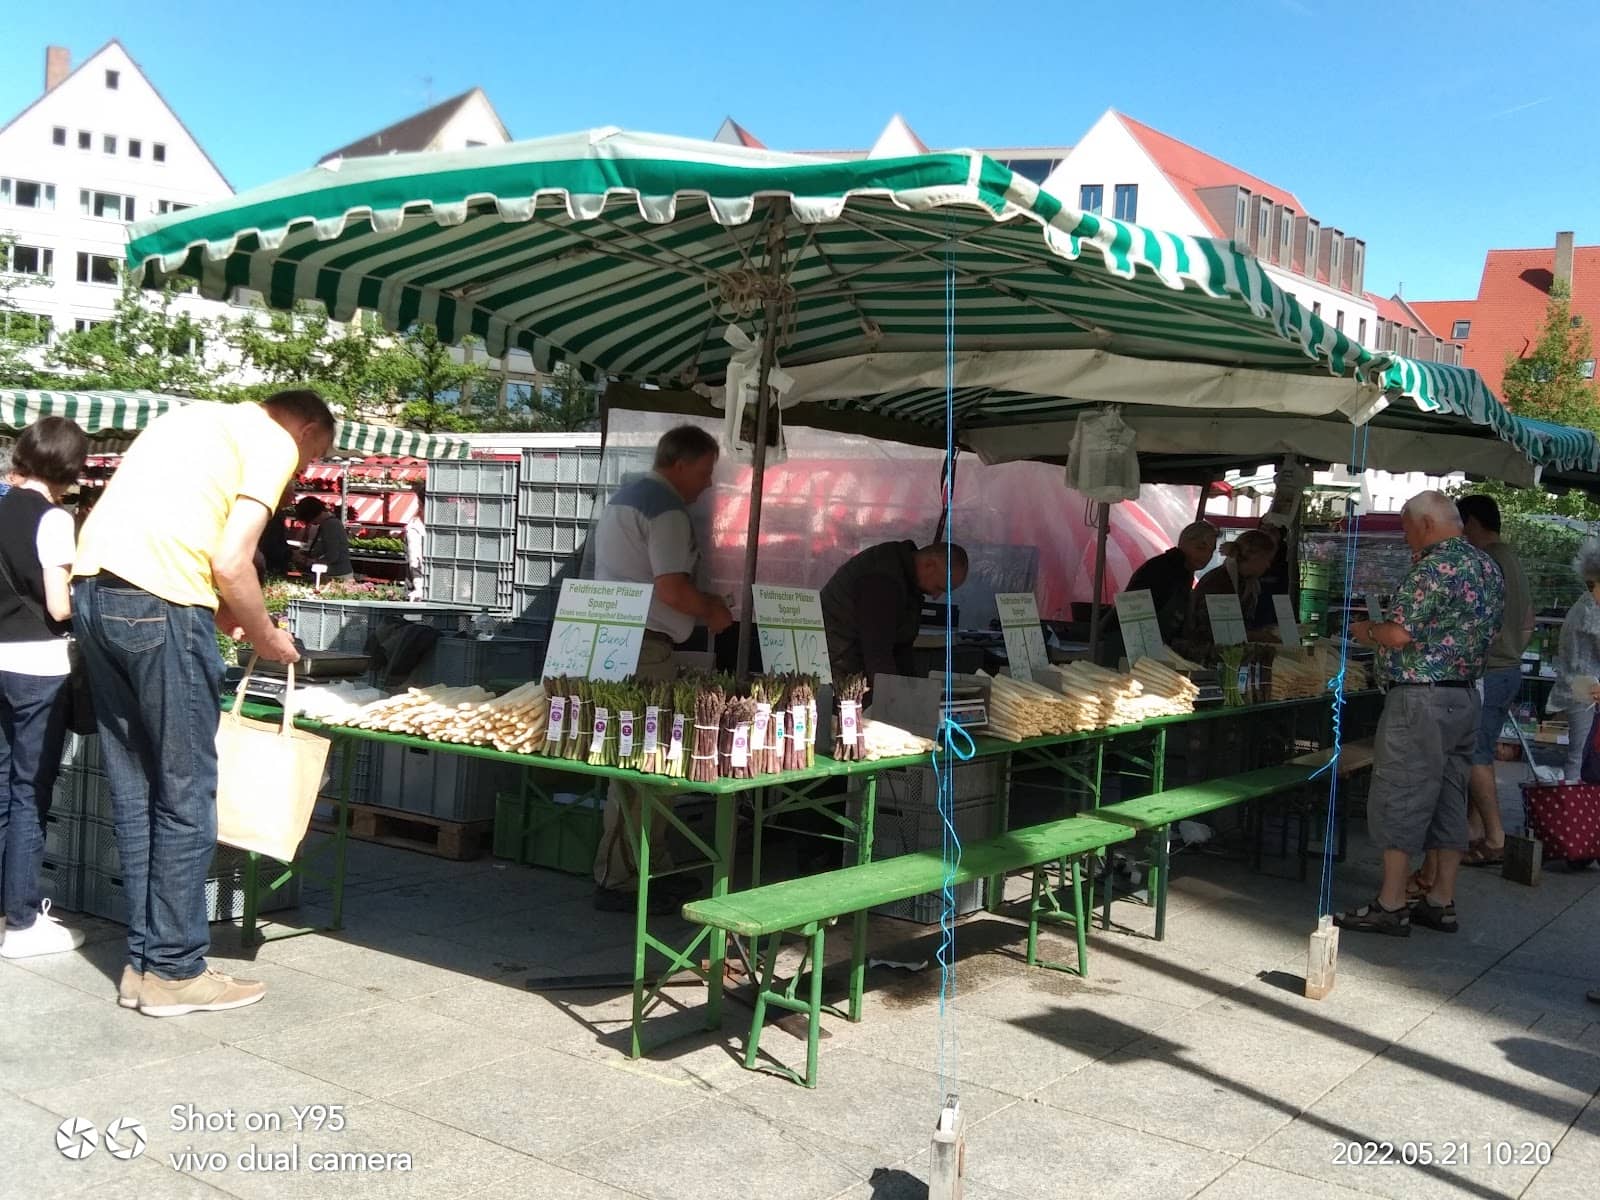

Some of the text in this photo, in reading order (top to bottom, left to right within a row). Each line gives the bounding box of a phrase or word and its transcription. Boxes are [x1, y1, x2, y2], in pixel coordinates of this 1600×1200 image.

[569, 583, 643, 598] Feldfrischer Pfälzer
[588, 598, 618, 611] Spargel
[778, 603, 801, 616] Spargel
[598, 626, 631, 648] Bund
[760, 630, 785, 647] Bund
